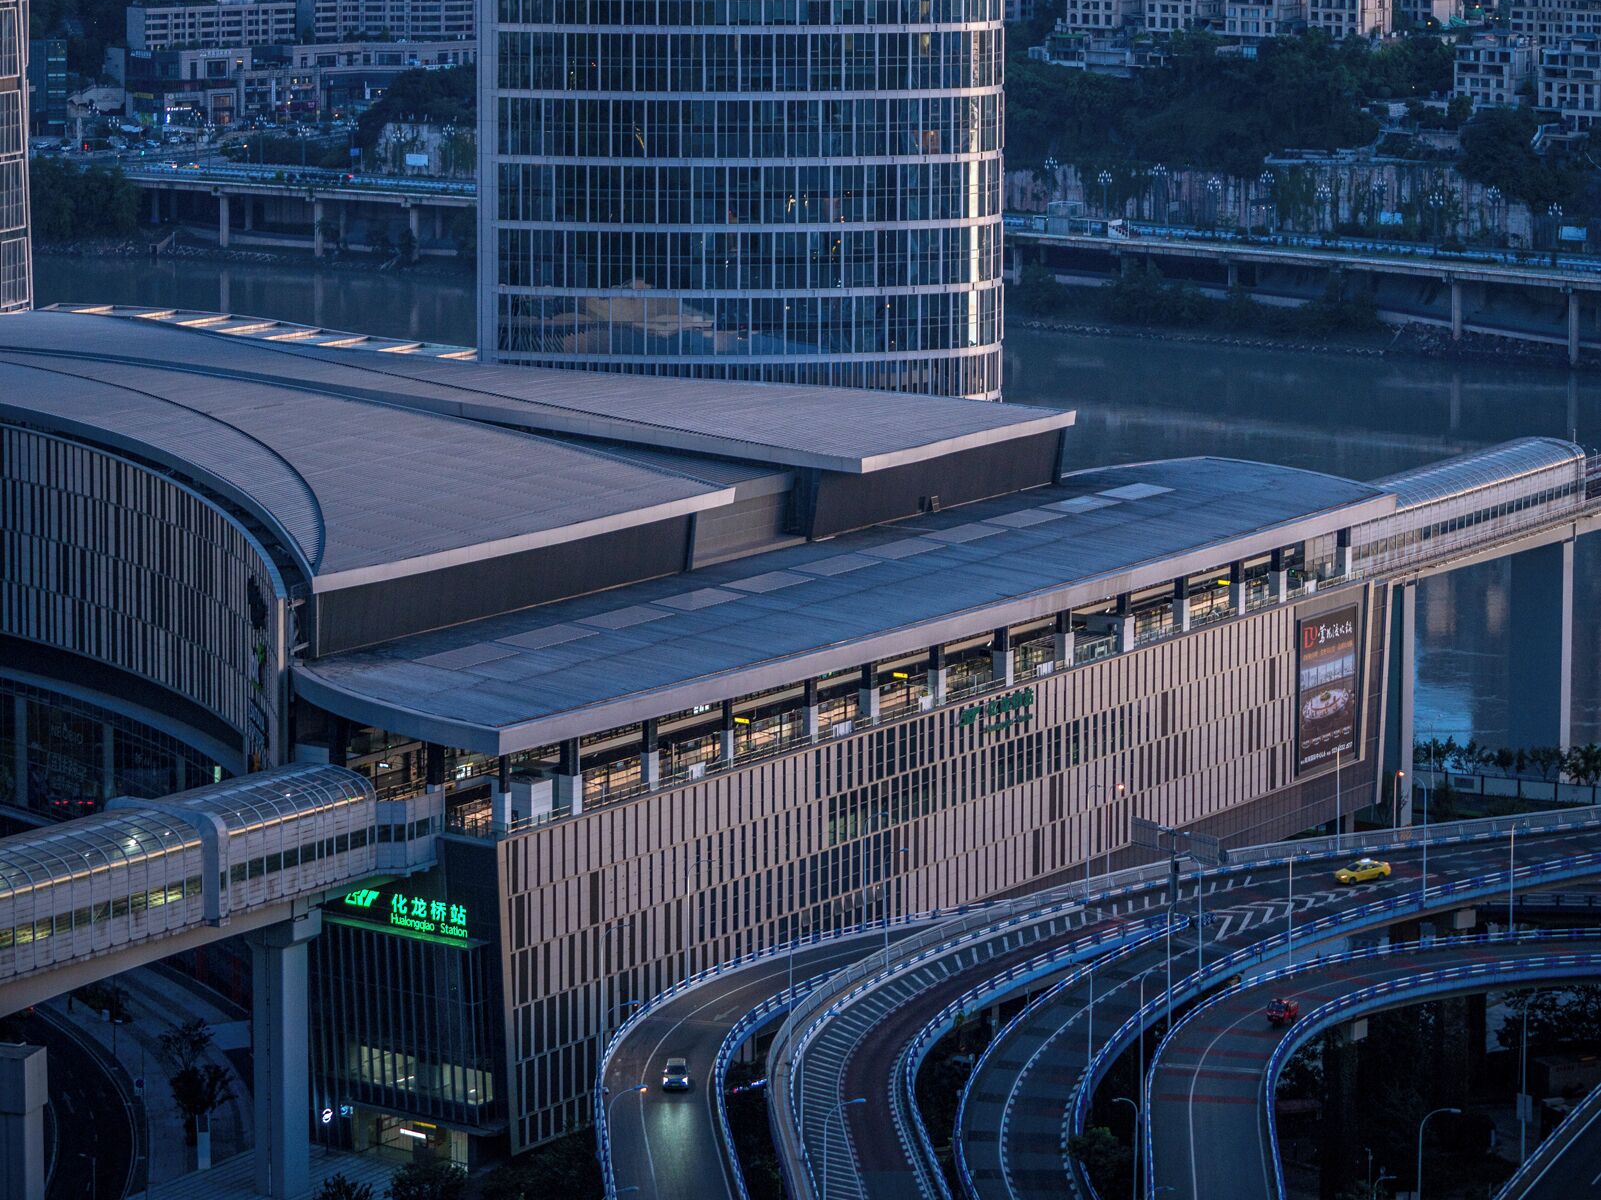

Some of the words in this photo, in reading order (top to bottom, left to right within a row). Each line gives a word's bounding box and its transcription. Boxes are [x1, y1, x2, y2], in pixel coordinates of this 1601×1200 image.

[391, 893, 467, 926] 化龙桥站
[390, 913, 435, 932] Hualongqiao
[440, 923, 468, 938] Station
